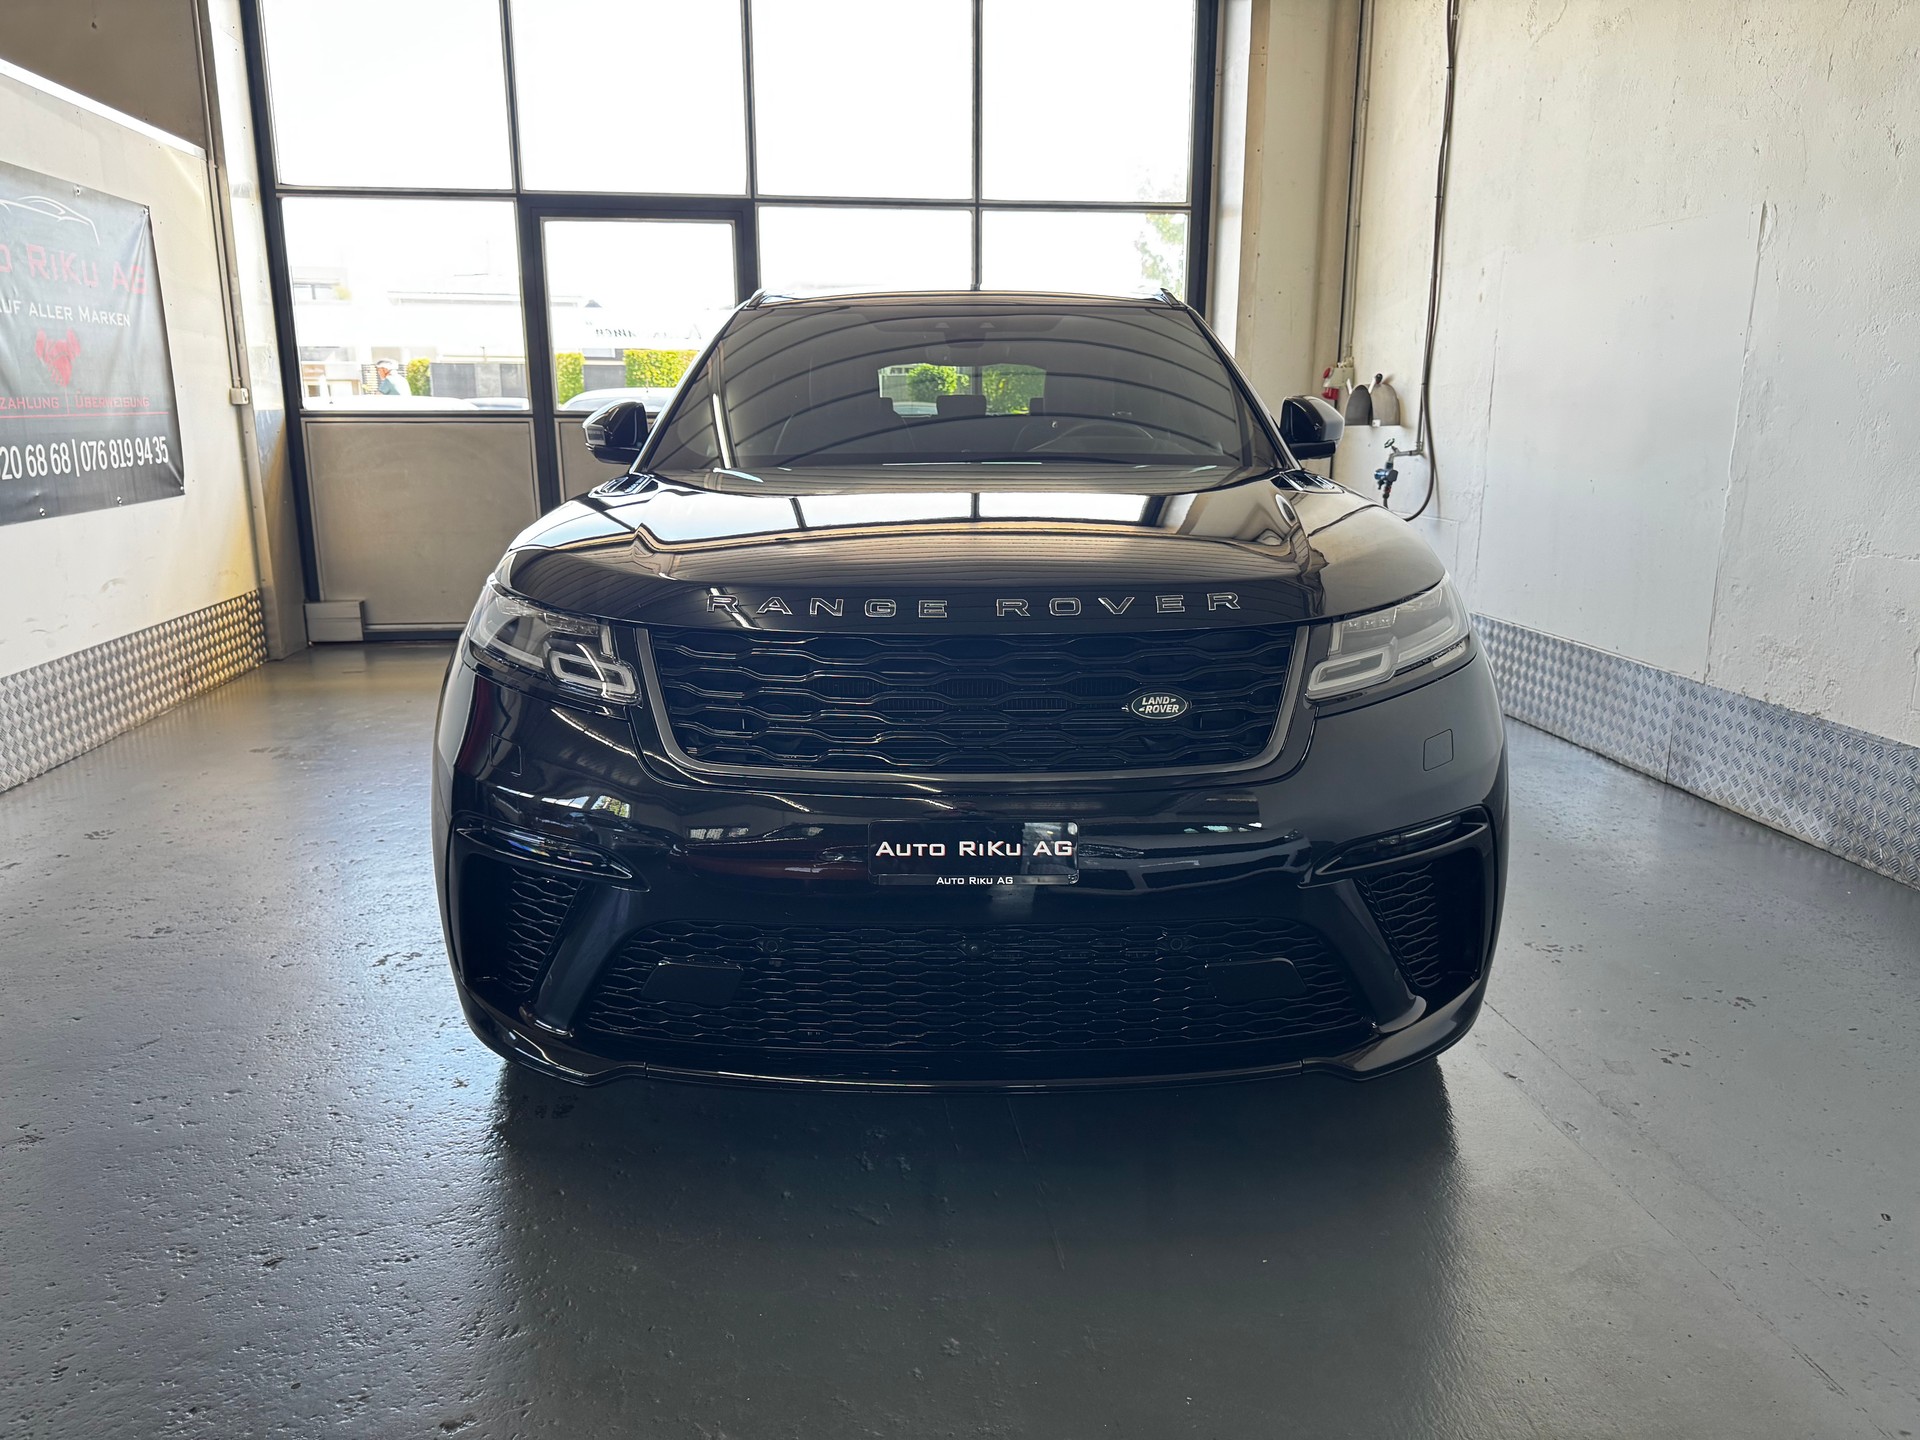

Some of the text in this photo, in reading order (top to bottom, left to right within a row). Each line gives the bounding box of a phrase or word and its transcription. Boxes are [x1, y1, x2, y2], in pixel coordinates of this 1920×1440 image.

[113, 261, 147, 294] AG
[29, 302, 73, 320] ALLER
[78, 305, 130, 327] MARKEN
[25, 444, 48, 477] 68
[50, 442, 71, 474] 68
[109, 438, 133, 469] 819
[135, 437, 153, 466] 94
[152, 436, 169, 464] 35
[706, 591, 1240, 618] RANGE ROVER
[1141, 696, 1170, 705] LAND
[1145, 704, 1180, 714] ROVER
[1033, 841, 1073, 857] AG
[997, 876, 1014, 885] AG
